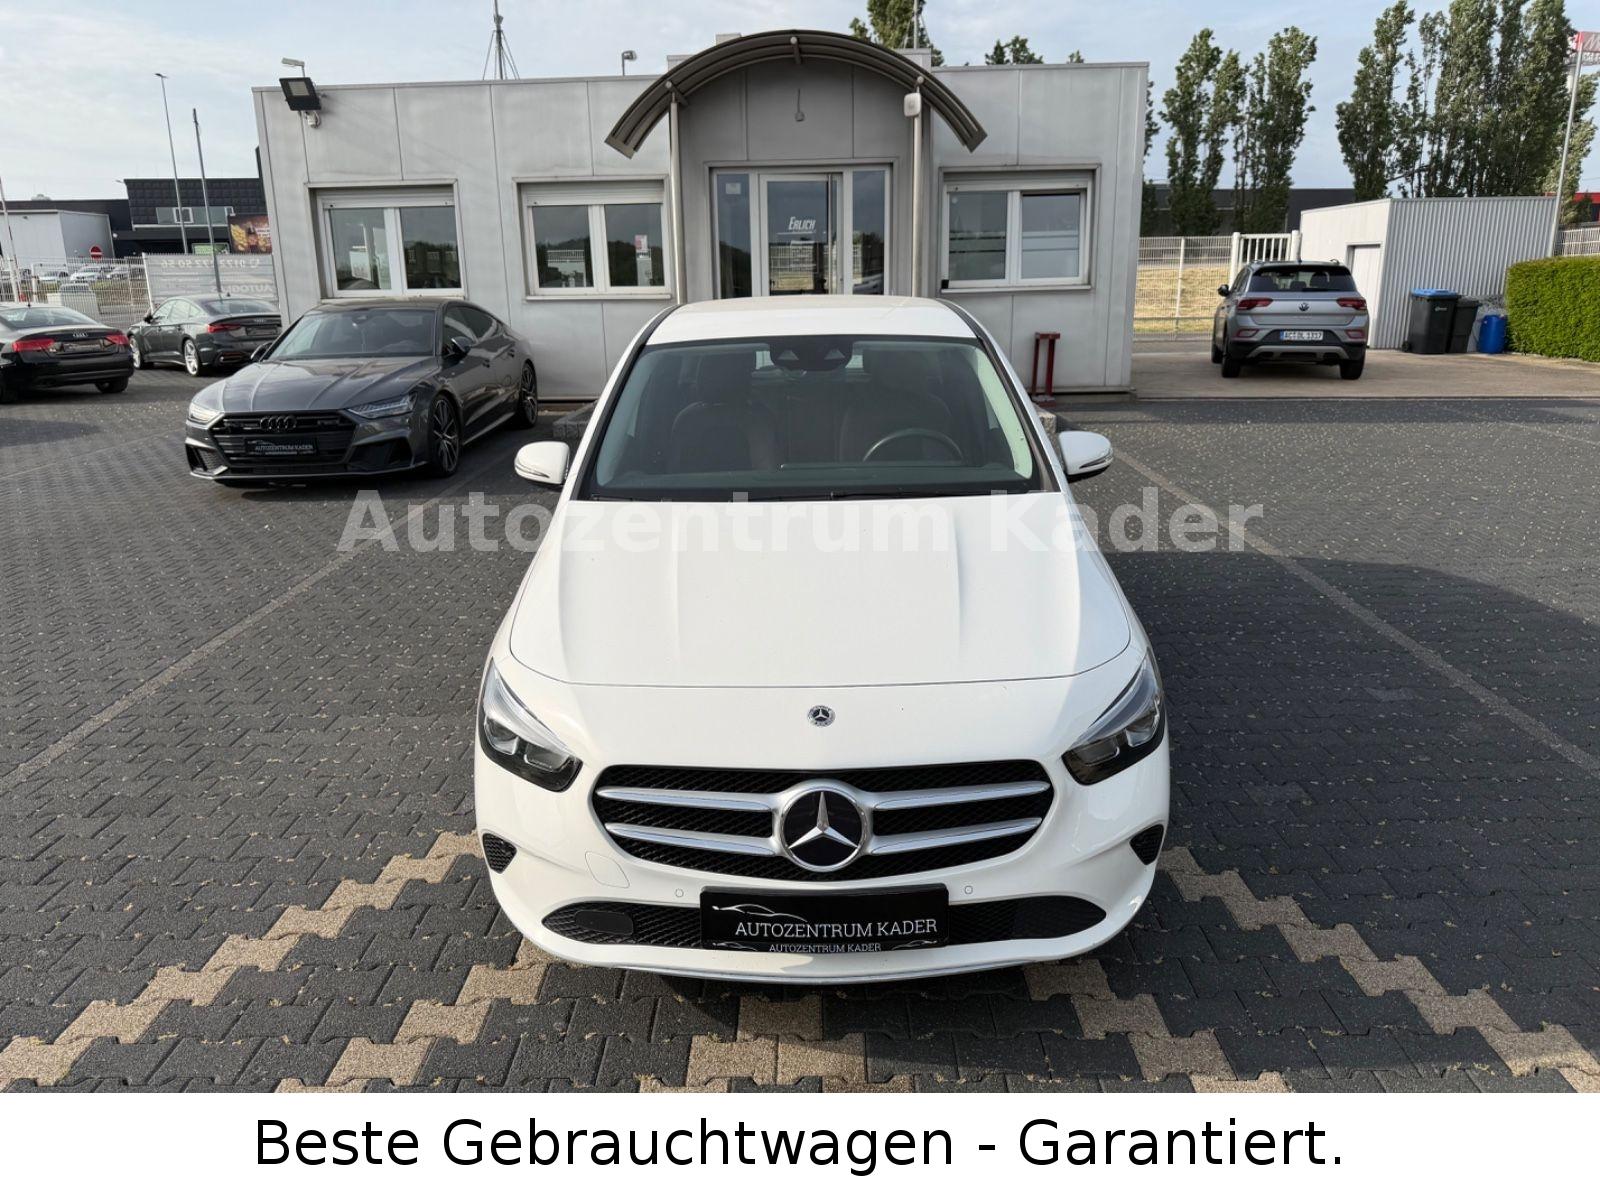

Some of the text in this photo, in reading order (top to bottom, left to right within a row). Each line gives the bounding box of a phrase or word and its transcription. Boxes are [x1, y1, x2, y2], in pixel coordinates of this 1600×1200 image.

[735, 918, 938, 939] AUTOZENTRUM KADER
[769, 942, 882, 953] AUTOZENTRUM KADER
